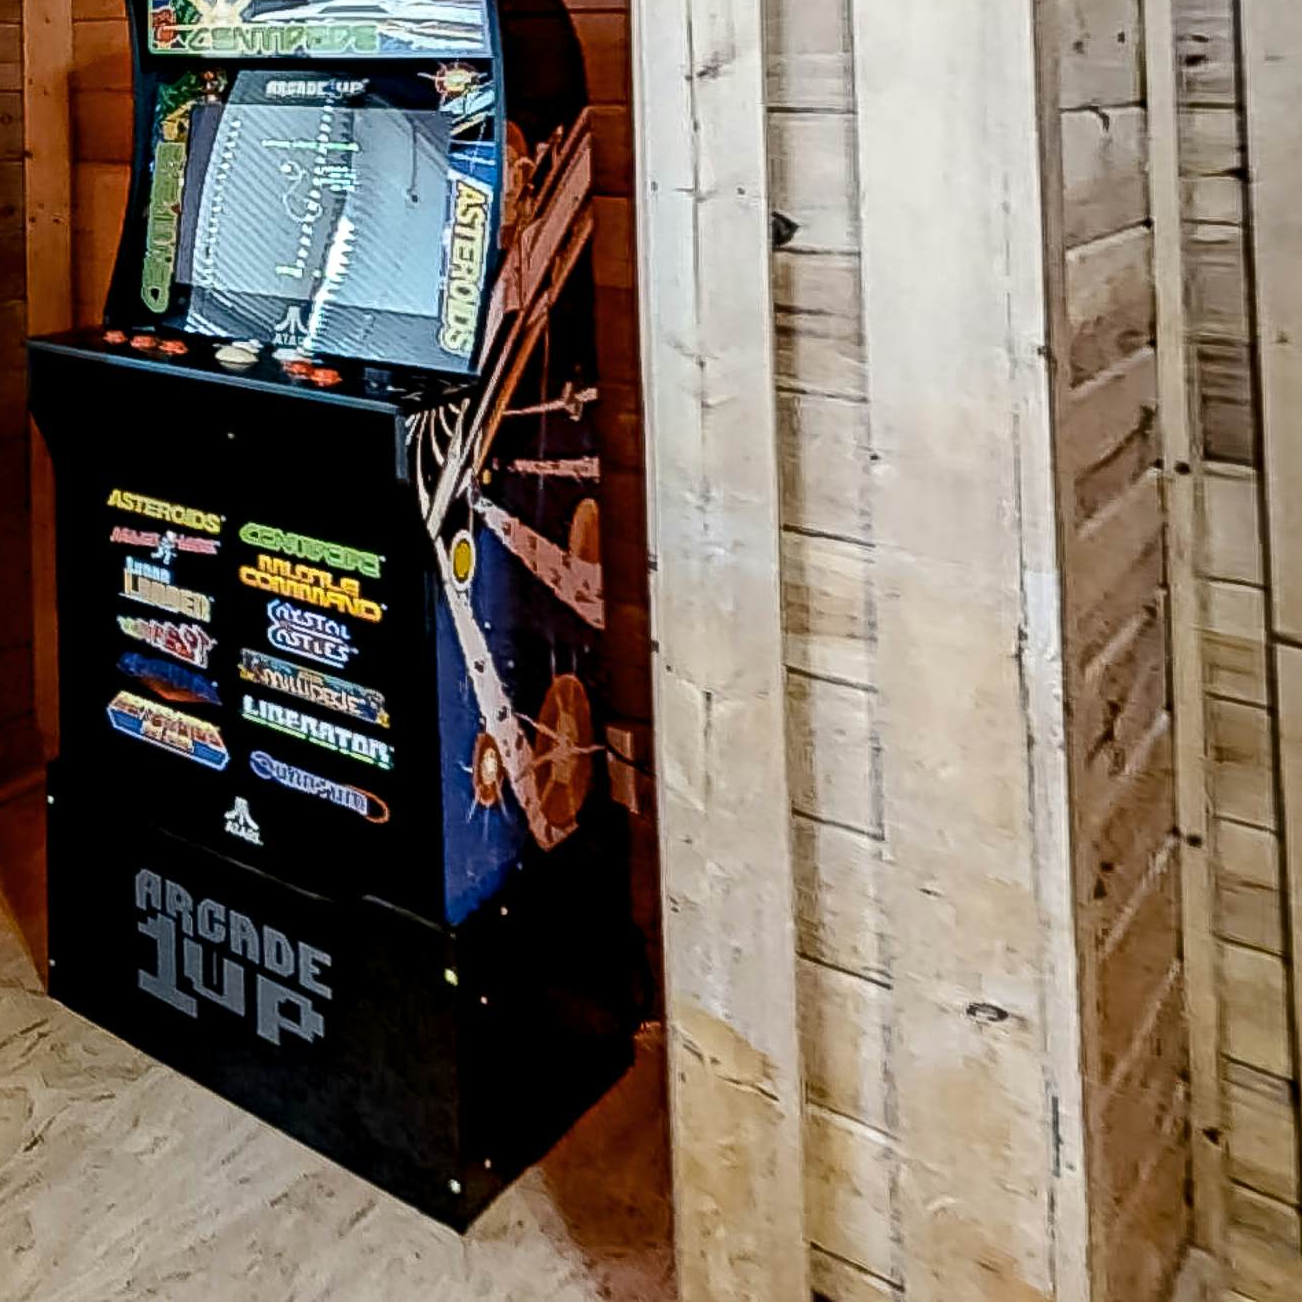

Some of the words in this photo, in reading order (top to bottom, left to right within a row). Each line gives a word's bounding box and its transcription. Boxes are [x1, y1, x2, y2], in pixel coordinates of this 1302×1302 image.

[188, 24, 378, 55] CENTIPEDE
[441, 180, 488, 354] ASTEROIDS
[107, 488, 221, 535] ASTEROIDS
[239, 522, 381, 578] CENTIPEDE
[239, 565, 383, 622] COMMAND
[267, 622, 351, 668] CASTLES
[243, 695, 391, 763] LIBERATOR
[135, 868, 332, 999] ARCADE
[138, 912, 324, 1045] 1UP
